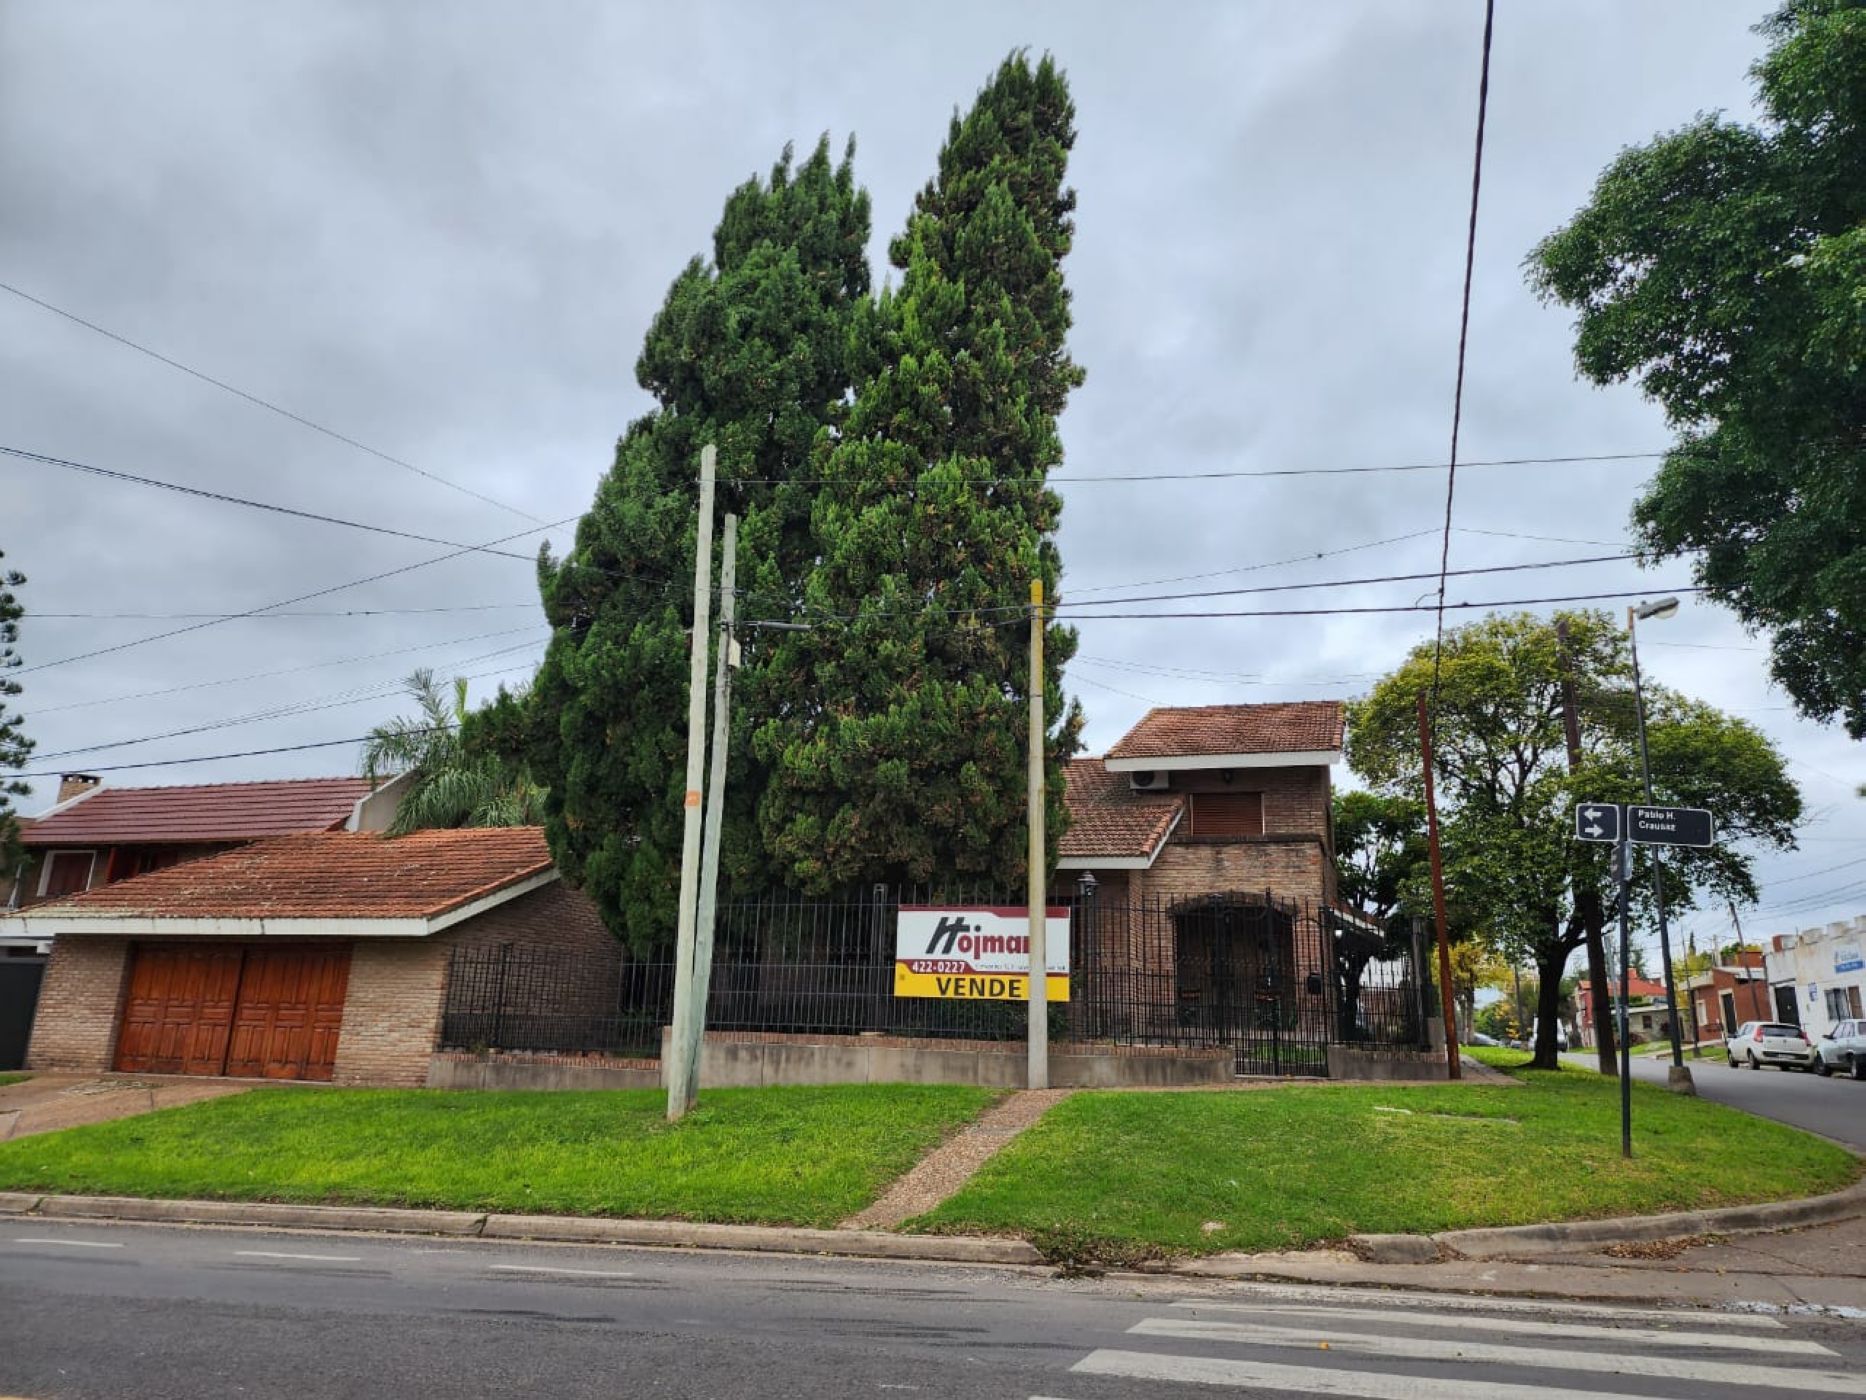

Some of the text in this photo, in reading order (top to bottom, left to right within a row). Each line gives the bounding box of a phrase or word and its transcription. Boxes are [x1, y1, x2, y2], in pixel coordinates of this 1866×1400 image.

[1638, 808, 1676, 820] Pablo H.
[912, 961, 965, 973] 422-0227
[936, 977, 1022, 997] VENDE
